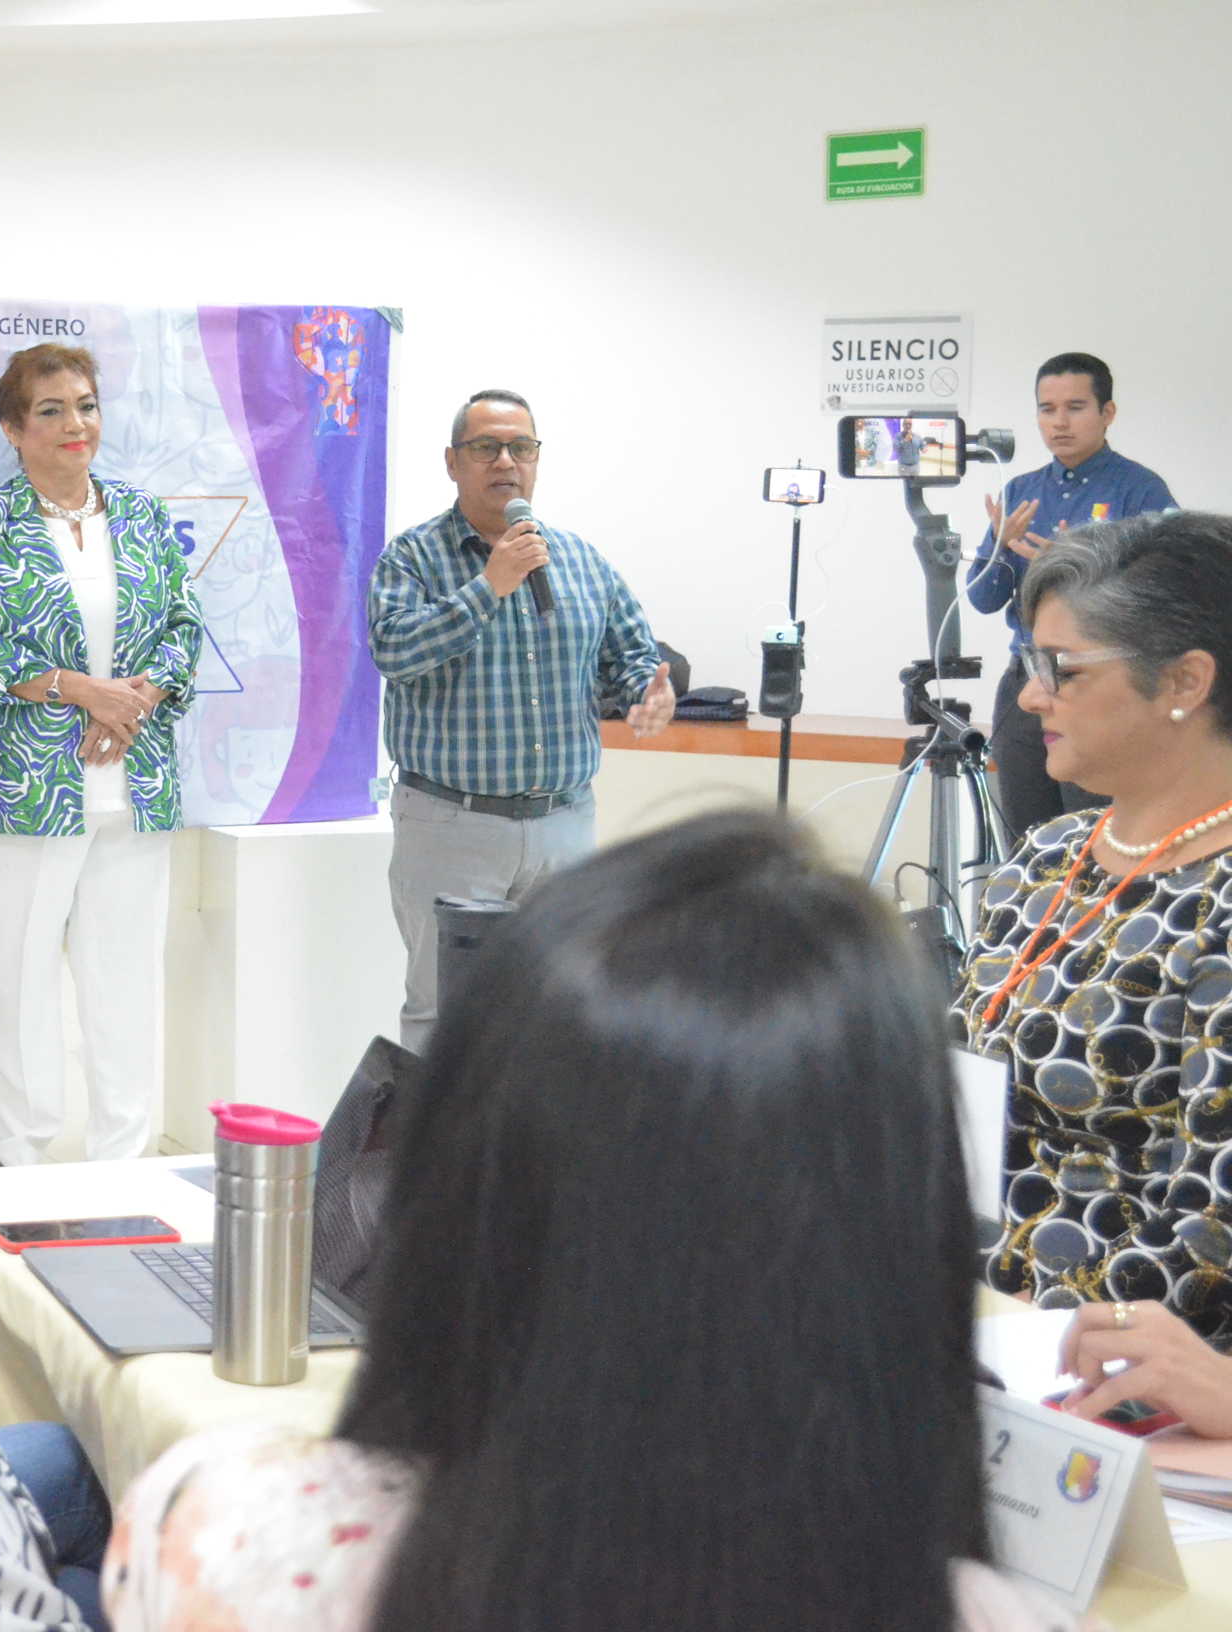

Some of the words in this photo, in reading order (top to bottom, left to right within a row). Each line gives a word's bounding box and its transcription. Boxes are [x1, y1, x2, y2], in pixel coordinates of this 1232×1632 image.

[831, 338, 960, 361] SILENCIO
[845, 367, 926, 381] USUARIOS
[827, 382, 926, 394] INVESTIGANDO
[988, 1429, 1012, 1465] 2
